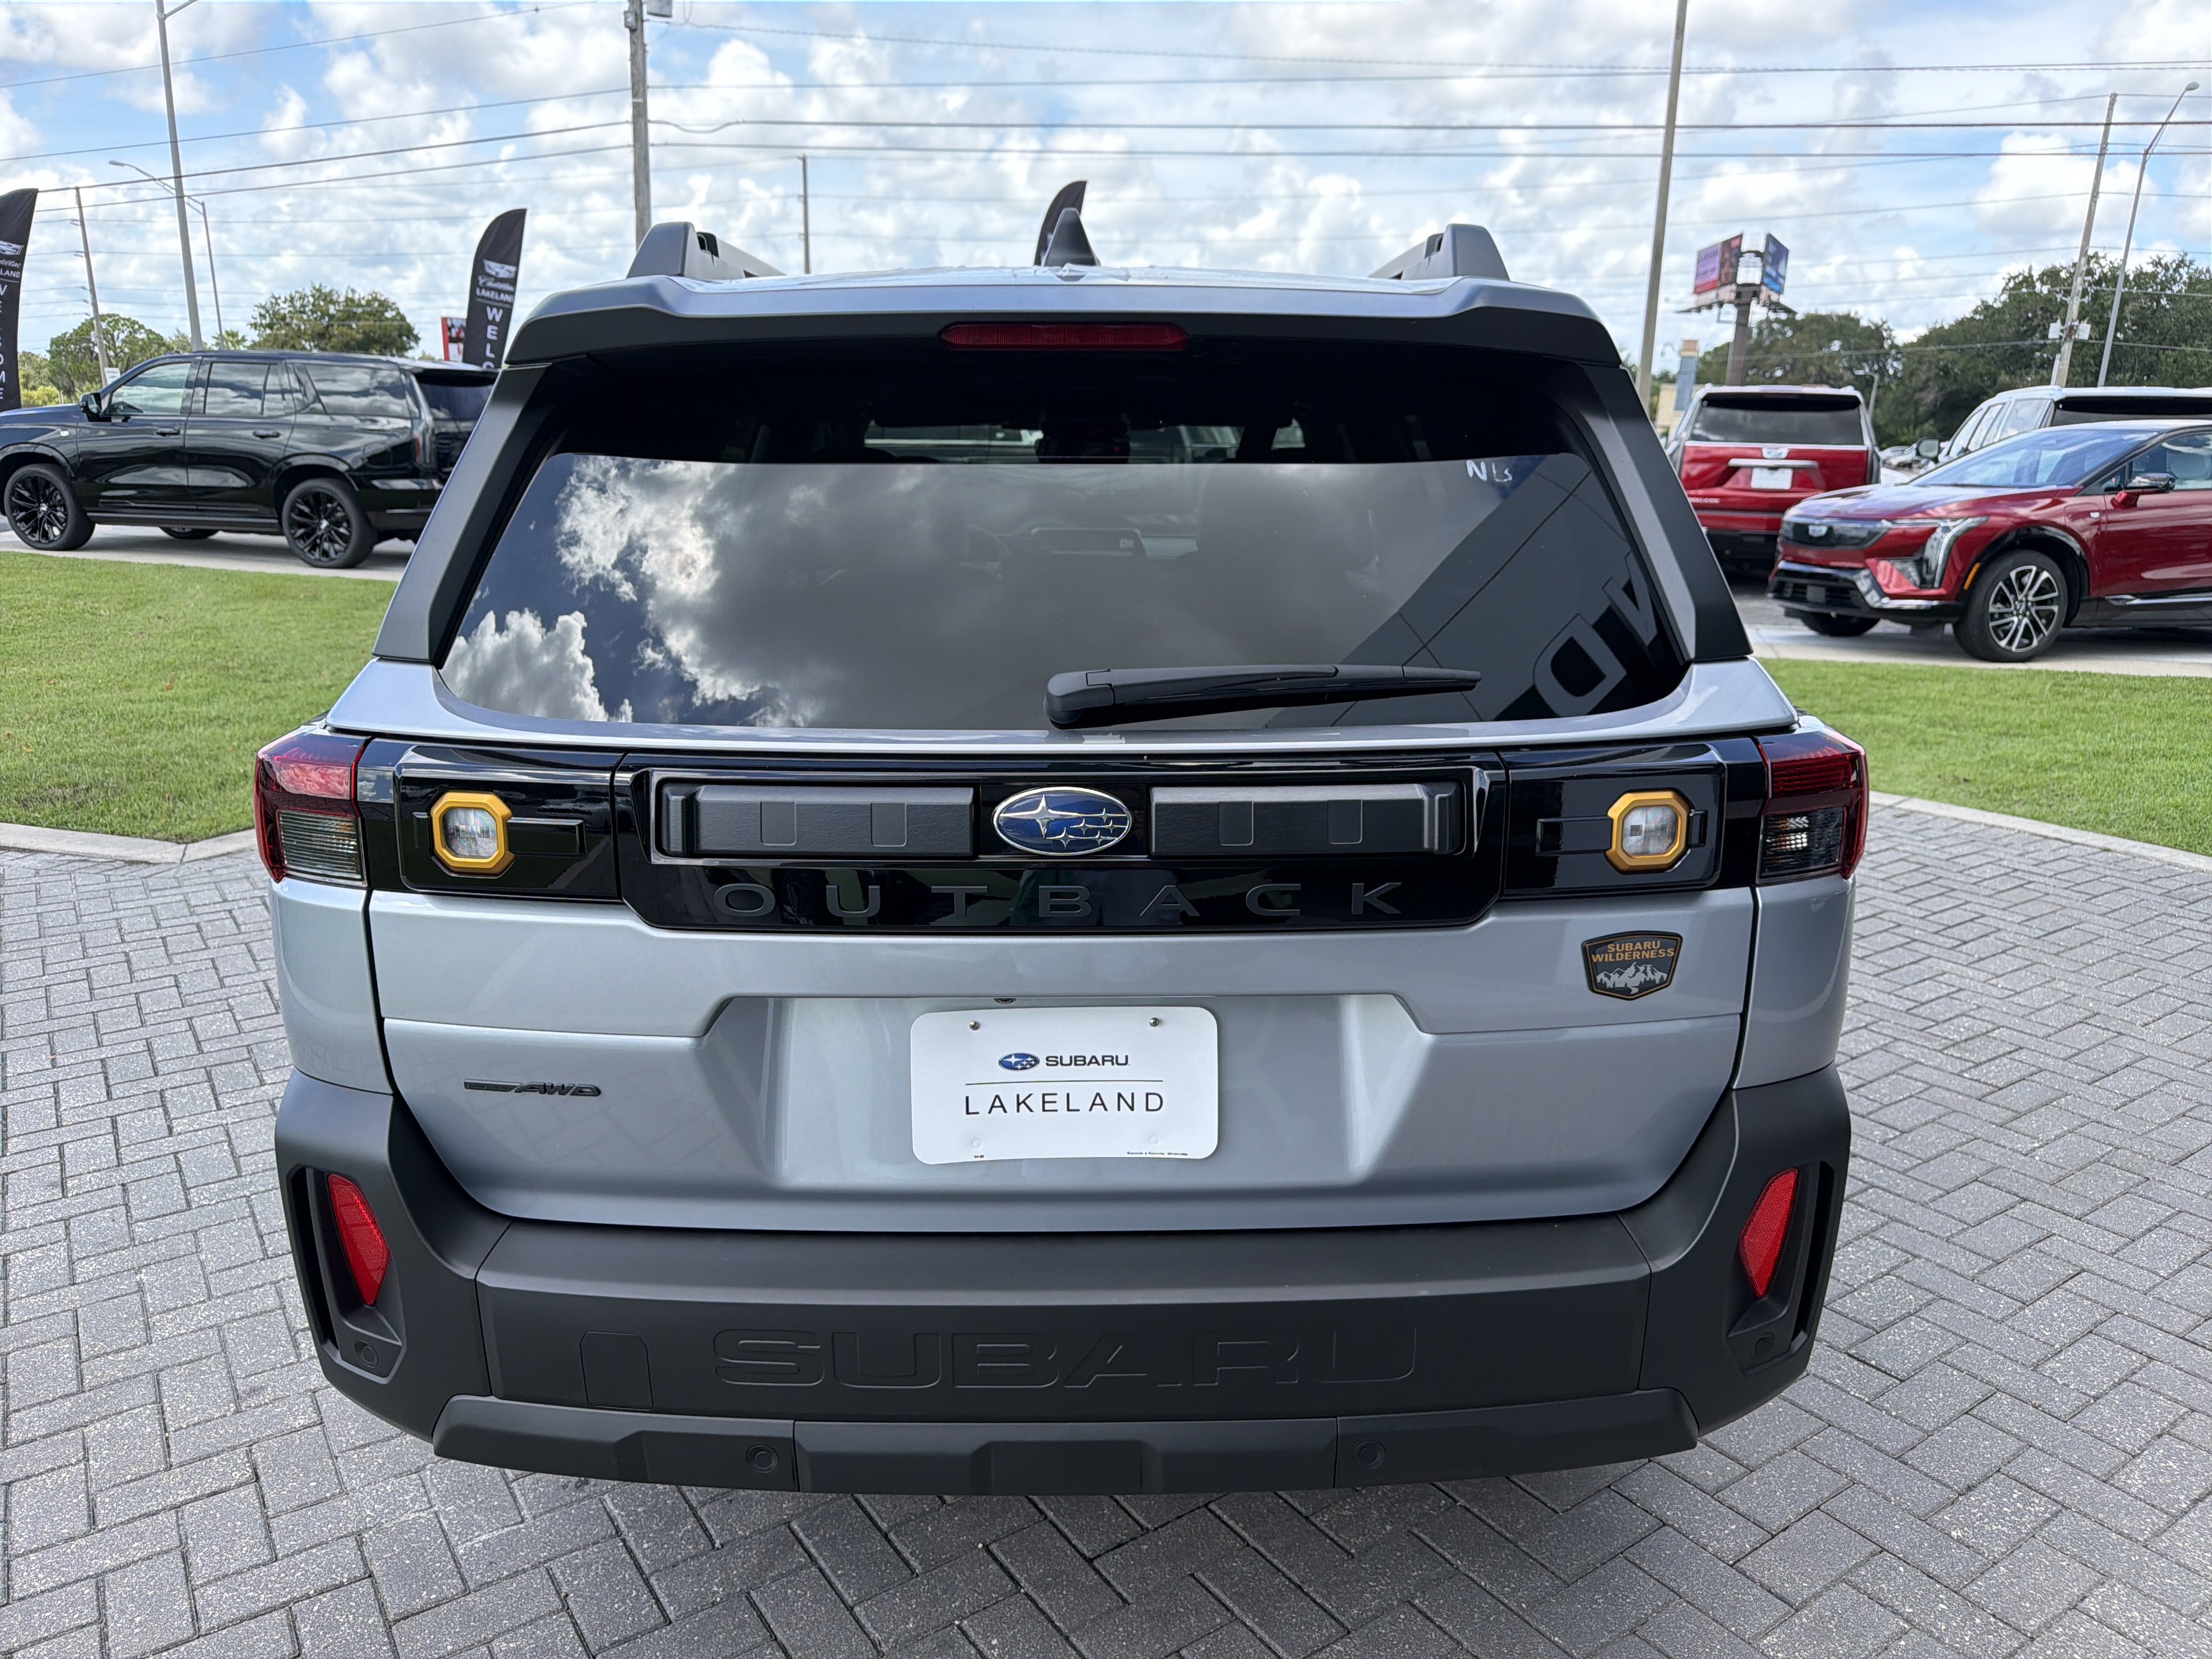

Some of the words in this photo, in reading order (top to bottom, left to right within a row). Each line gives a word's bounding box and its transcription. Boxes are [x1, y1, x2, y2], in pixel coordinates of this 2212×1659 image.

[713, 882, 1402, 918] OUTBACK
[1607, 940, 1661, 953] SUBARU
[1592, 948, 1675, 963] WILDERNESS
[1045, 1054, 1130, 1067] SUBARU
[514, 1082, 601, 1097] AWD
[965, 1091, 1164, 1115] LAKELAND
[714, 1326, 1417, 1389] SUBARU
